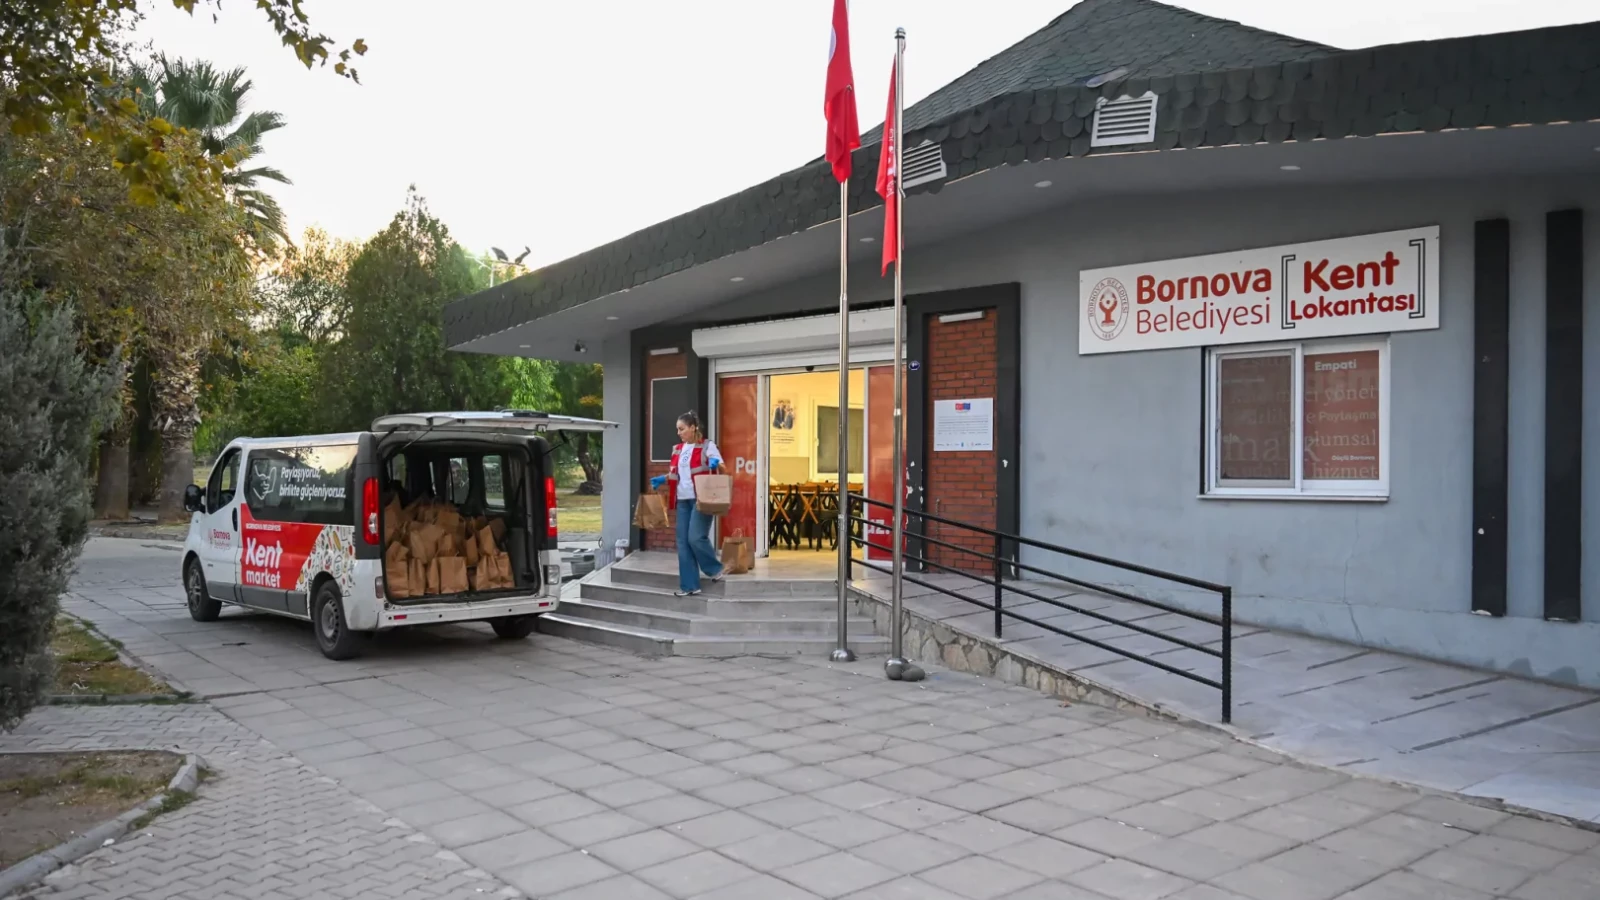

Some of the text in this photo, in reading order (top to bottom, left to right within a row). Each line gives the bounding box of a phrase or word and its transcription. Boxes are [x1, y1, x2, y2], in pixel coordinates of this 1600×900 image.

[1136, 267, 1272, 304] Bornova
[1303, 250, 1400, 294] Kent
[1136, 297, 1271, 335] Belediyesi
[1290, 293, 1415, 321] Lokantası
[1314, 358, 1357, 373] Empati
[735, 456, 758, 475] Pa
[279, 484, 346, 501] birlikte güçleniyoruz.
[245, 536, 284, 569] Kent
[246, 568, 281, 588] market
